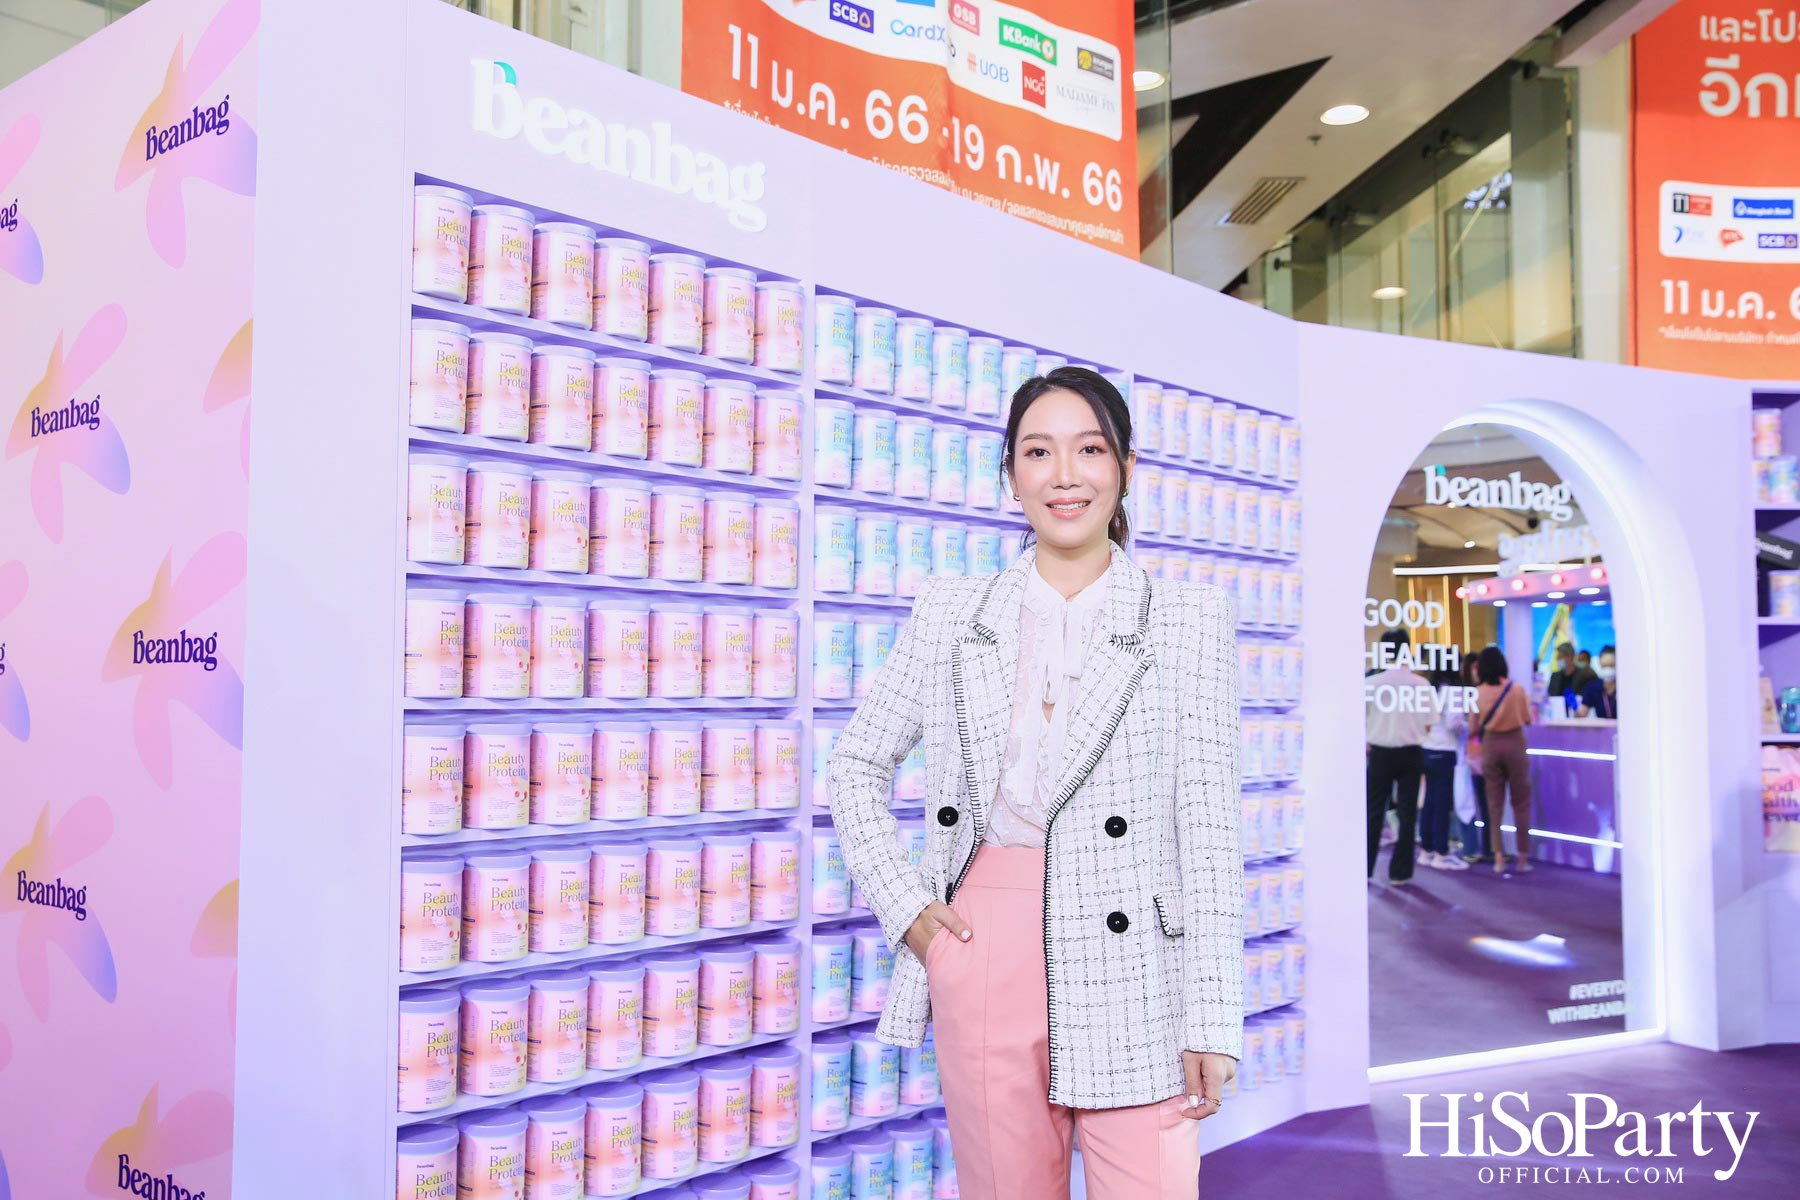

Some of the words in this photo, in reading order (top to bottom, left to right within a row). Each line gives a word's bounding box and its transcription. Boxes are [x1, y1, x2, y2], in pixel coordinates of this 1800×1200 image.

[832, 2, 858, 24] SCB
[1699, 8, 1800, 44] และโป
[1003, 24, 1042, 51] KBank
[979, 59, 1009, 83] UOB
[1698, 53, 1800, 118] อีก
[145, 94, 231, 161] beanbag
[470, 59, 768, 234] beanbag
[865, 89, 929, 145] 66
[995, 145, 1071, 199] ก.พ.
[1083, 162, 1122, 212] 66
[1700, 288, 1777, 320] ม.ค.
[31, 394, 100, 438] beanbag
[1424, 463, 1574, 521] beanbag
[1364, 598, 1445, 629] GOOD
[133, 629, 218, 671] beanbag
[1363, 642, 1459, 672] HEALTH
[1364, 684, 1480, 714] FOREVER
[488, 753, 526, 768] Beauty
[488, 766, 526, 777] Protein
[17, 870, 87, 921] beanbag
